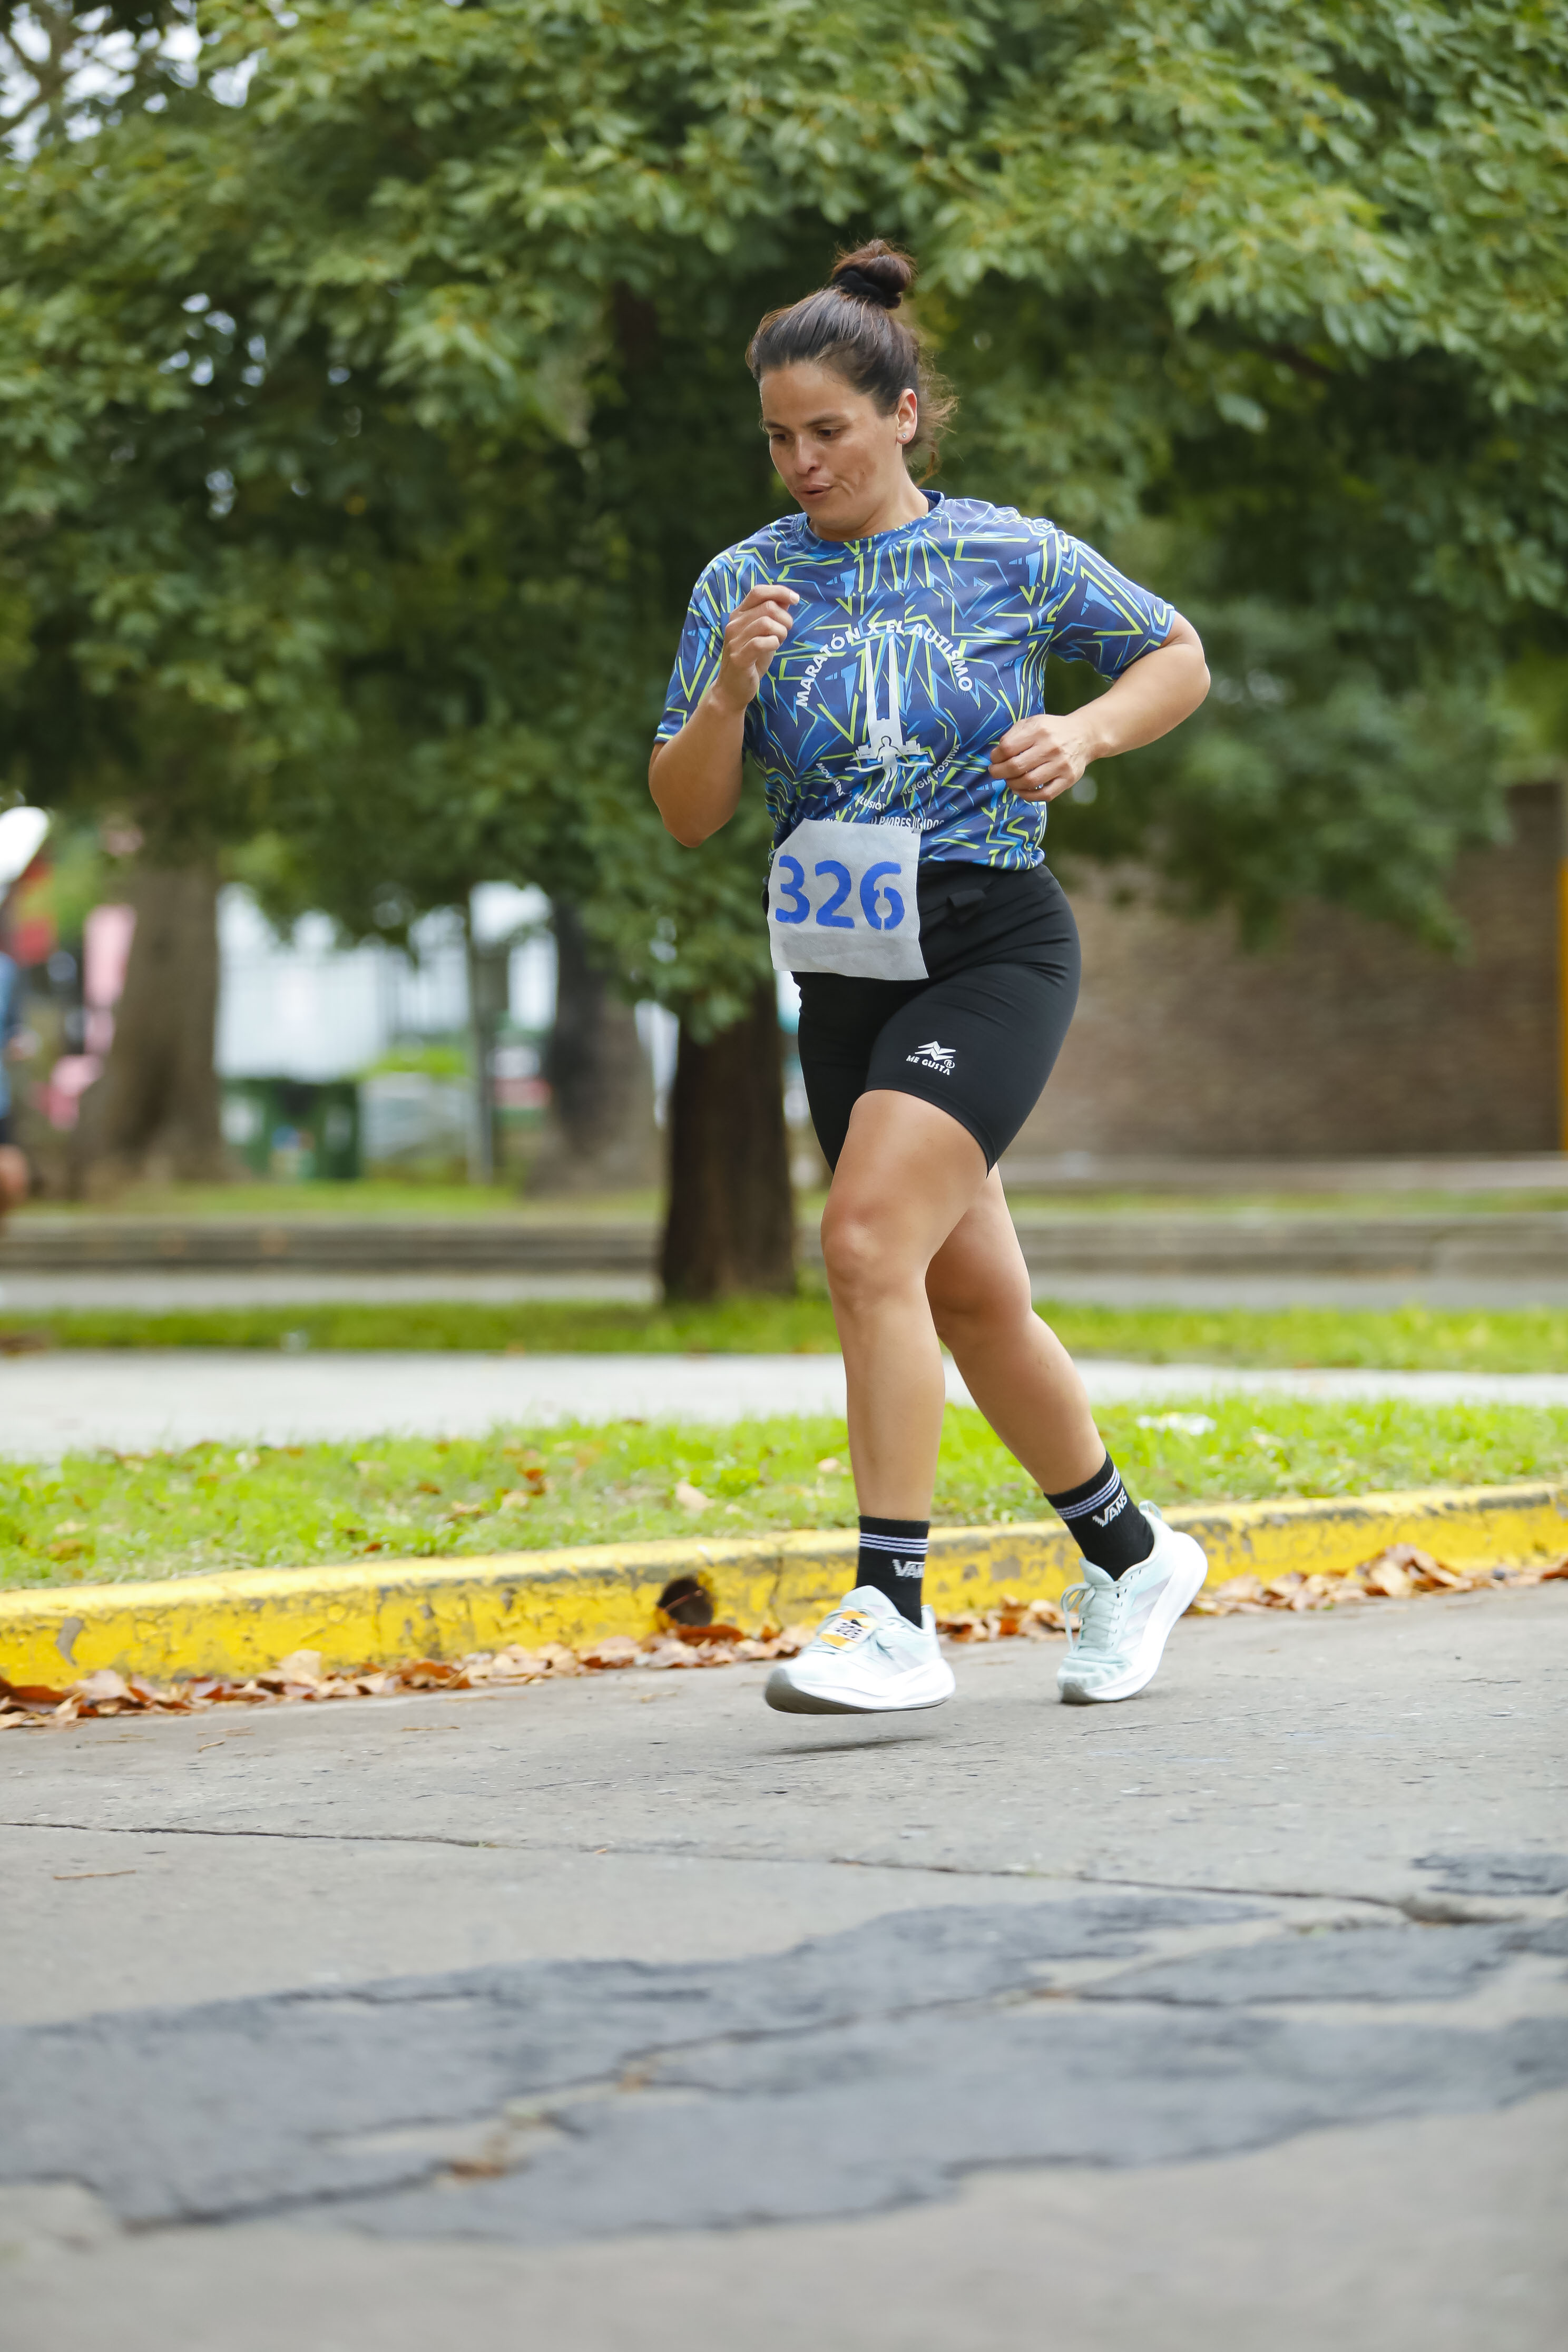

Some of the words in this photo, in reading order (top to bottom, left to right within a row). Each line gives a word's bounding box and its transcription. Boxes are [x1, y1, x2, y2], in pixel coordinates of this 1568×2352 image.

[796, 627, 861, 707] MARATÓN
[867, 622, 880, 636] X
[886, 620, 905, 633] EL
[909, 623, 973, 691] AUTISMO
[932, 743, 961, 778] POSITIVA
[775, 855, 905, 930] 326
[906, 1055, 920, 1063] ME
[922, 1059, 950, 1075] GUSTA
[1092, 1486, 1128, 1527] VANS
[892, 1559, 926, 1579] VAN
